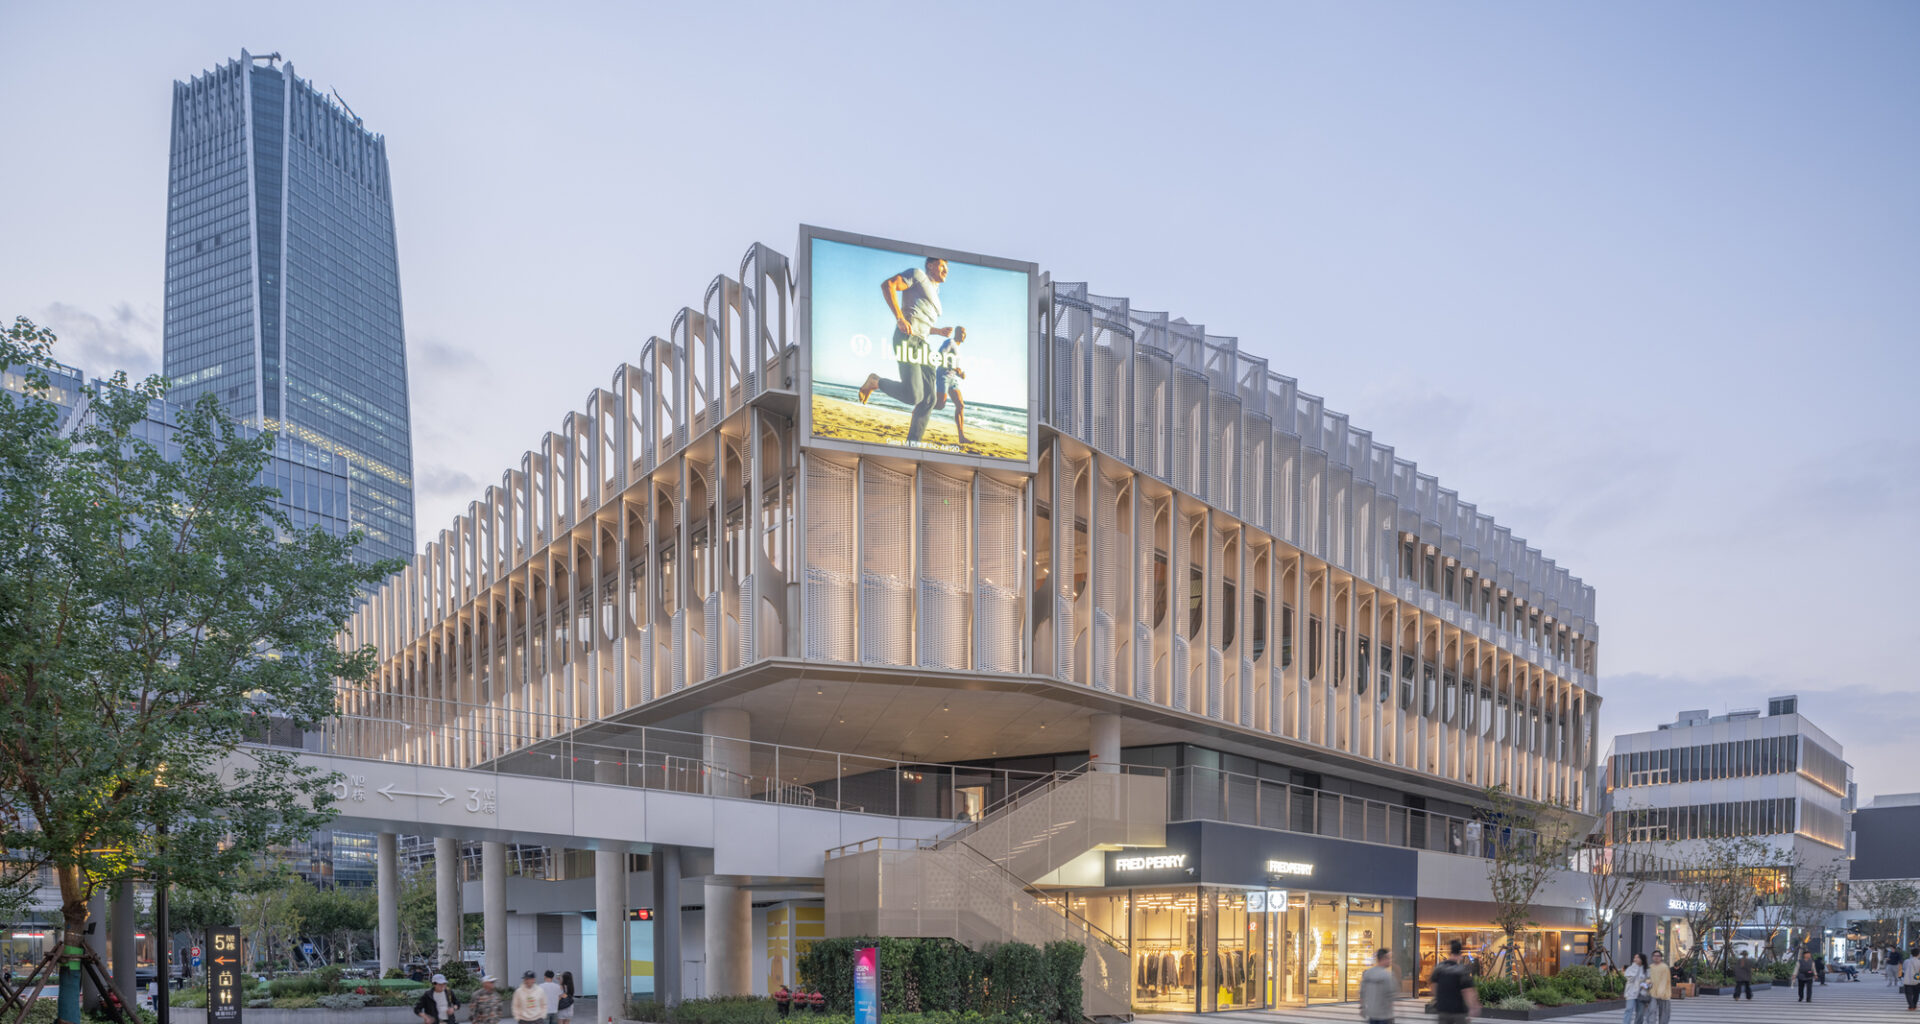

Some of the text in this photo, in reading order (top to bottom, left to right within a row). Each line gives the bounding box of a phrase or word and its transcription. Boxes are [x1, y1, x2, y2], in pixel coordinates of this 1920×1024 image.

[465, 787, 480, 813] 3
[1116, 855, 1186, 871] FRED PERRY
[215, 934, 225, 951] 5
